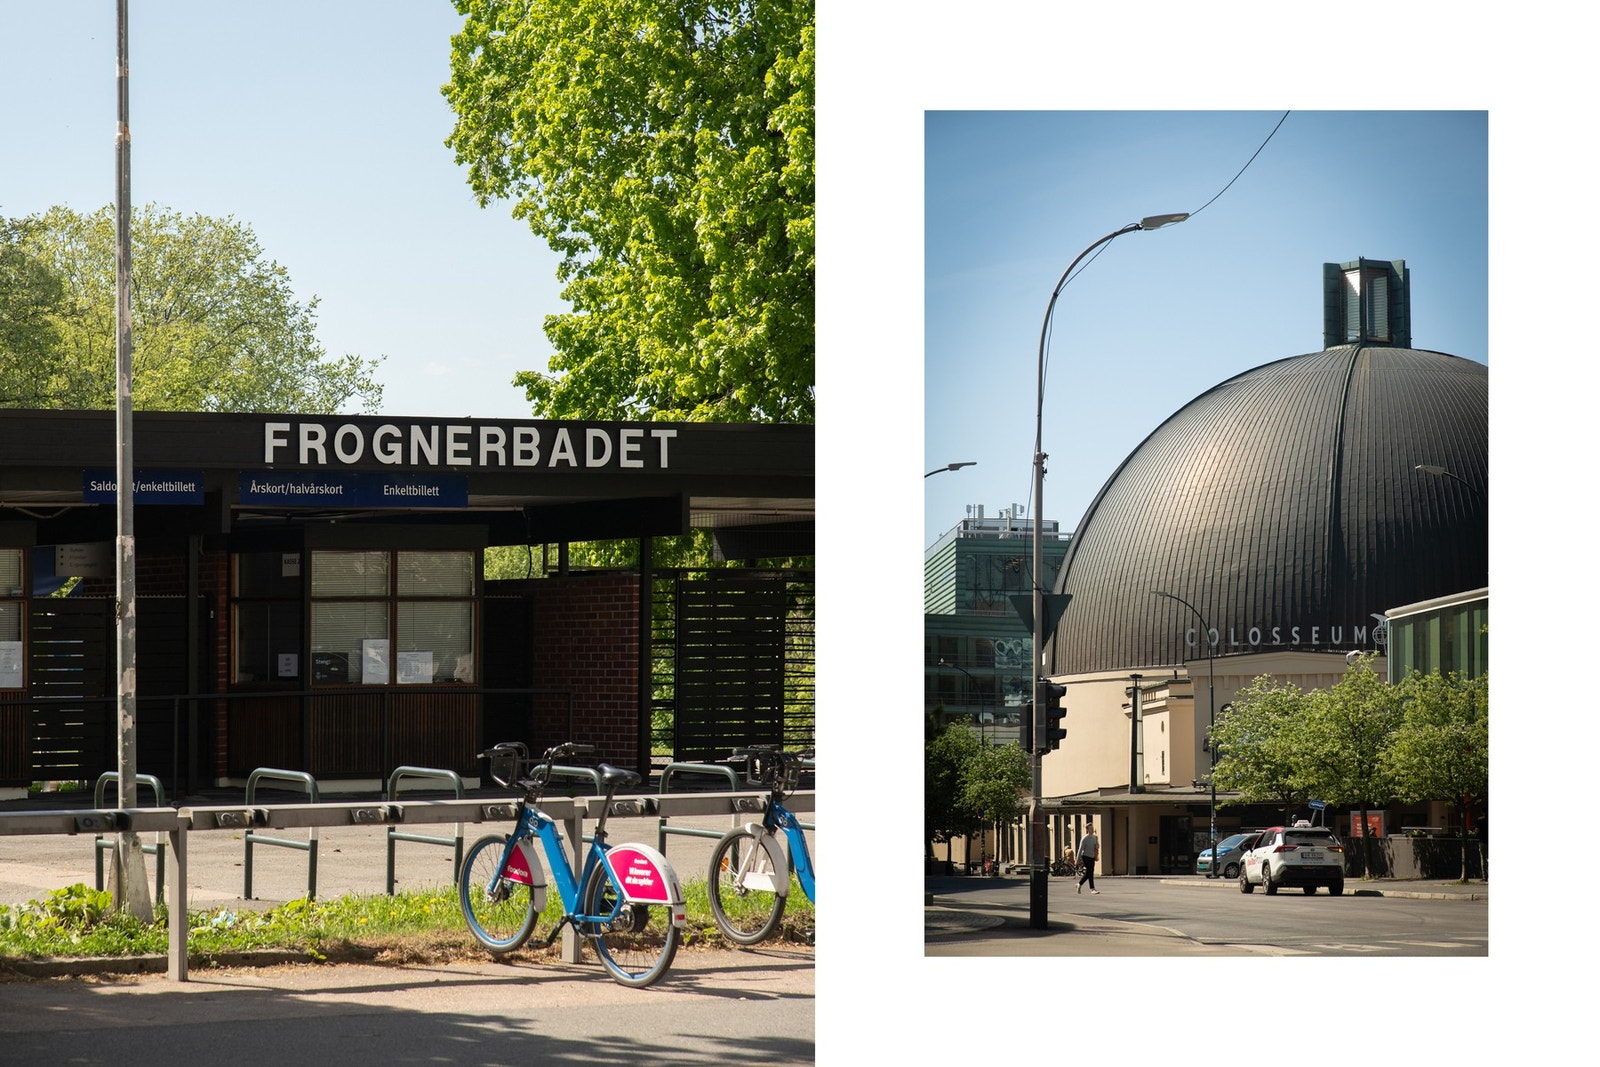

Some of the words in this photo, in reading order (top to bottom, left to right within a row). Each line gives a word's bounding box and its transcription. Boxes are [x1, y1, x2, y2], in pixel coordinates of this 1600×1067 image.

[264, 422, 678, 468] FROGNERBADET
[90, 480, 196, 493] Saldot/enkeltbillett
[250, 480, 344, 496] Årskort/halvårskort
[383, 484, 440, 497] Enkeltbillett
[1185, 625, 1367, 647] COLOSSEUM
